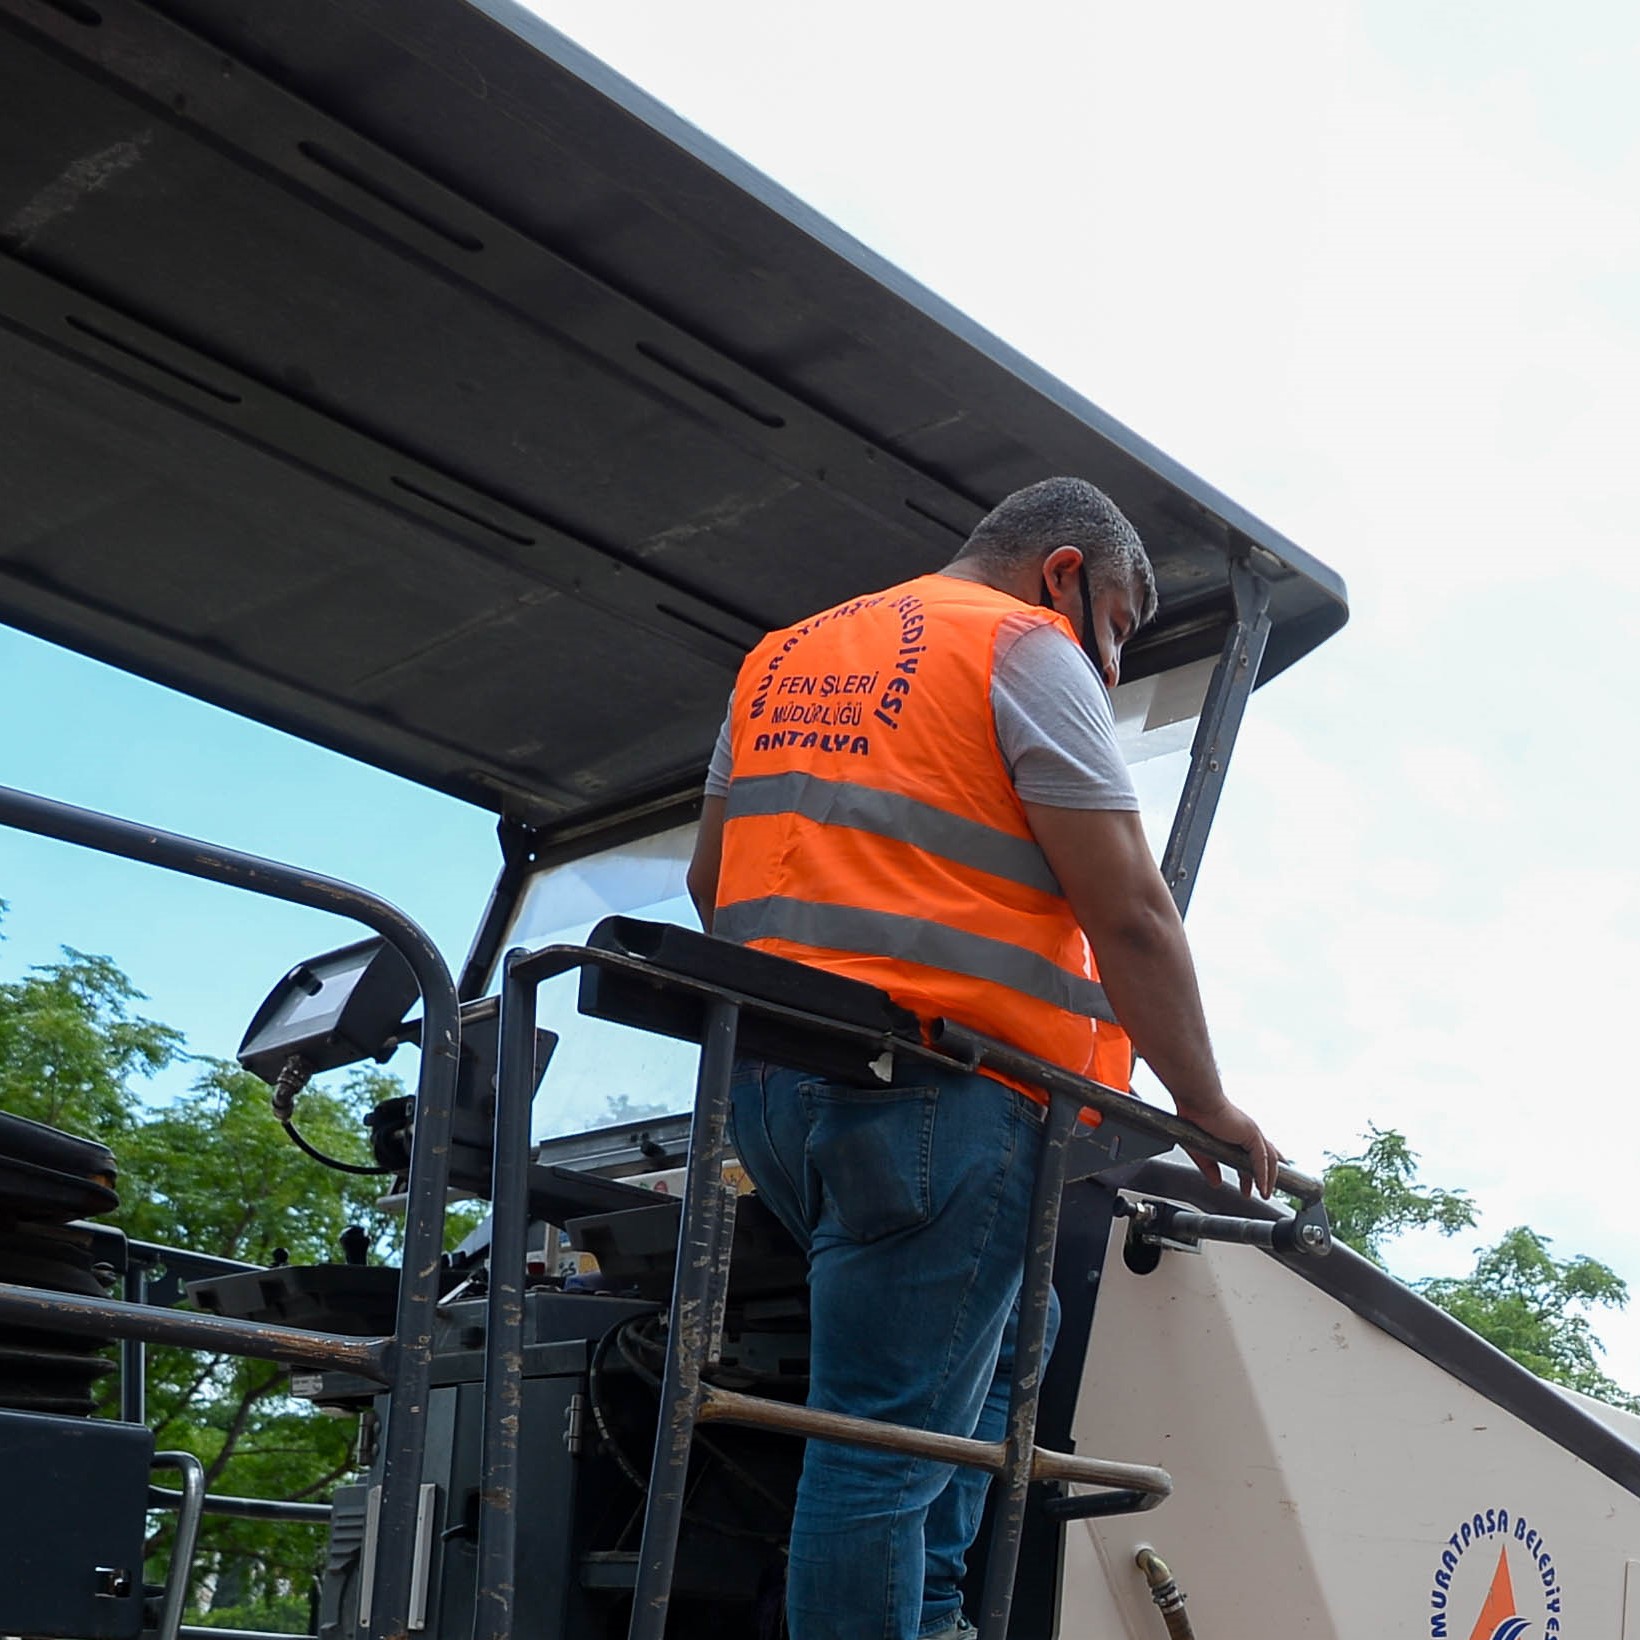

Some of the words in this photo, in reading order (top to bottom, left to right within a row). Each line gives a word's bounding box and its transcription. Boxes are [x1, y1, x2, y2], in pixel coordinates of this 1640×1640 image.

[777, 676, 817, 695] FEN
[754, 731, 868, 755] ANTALYA
[1431, 1508, 1508, 1638] MURATPAŞA
